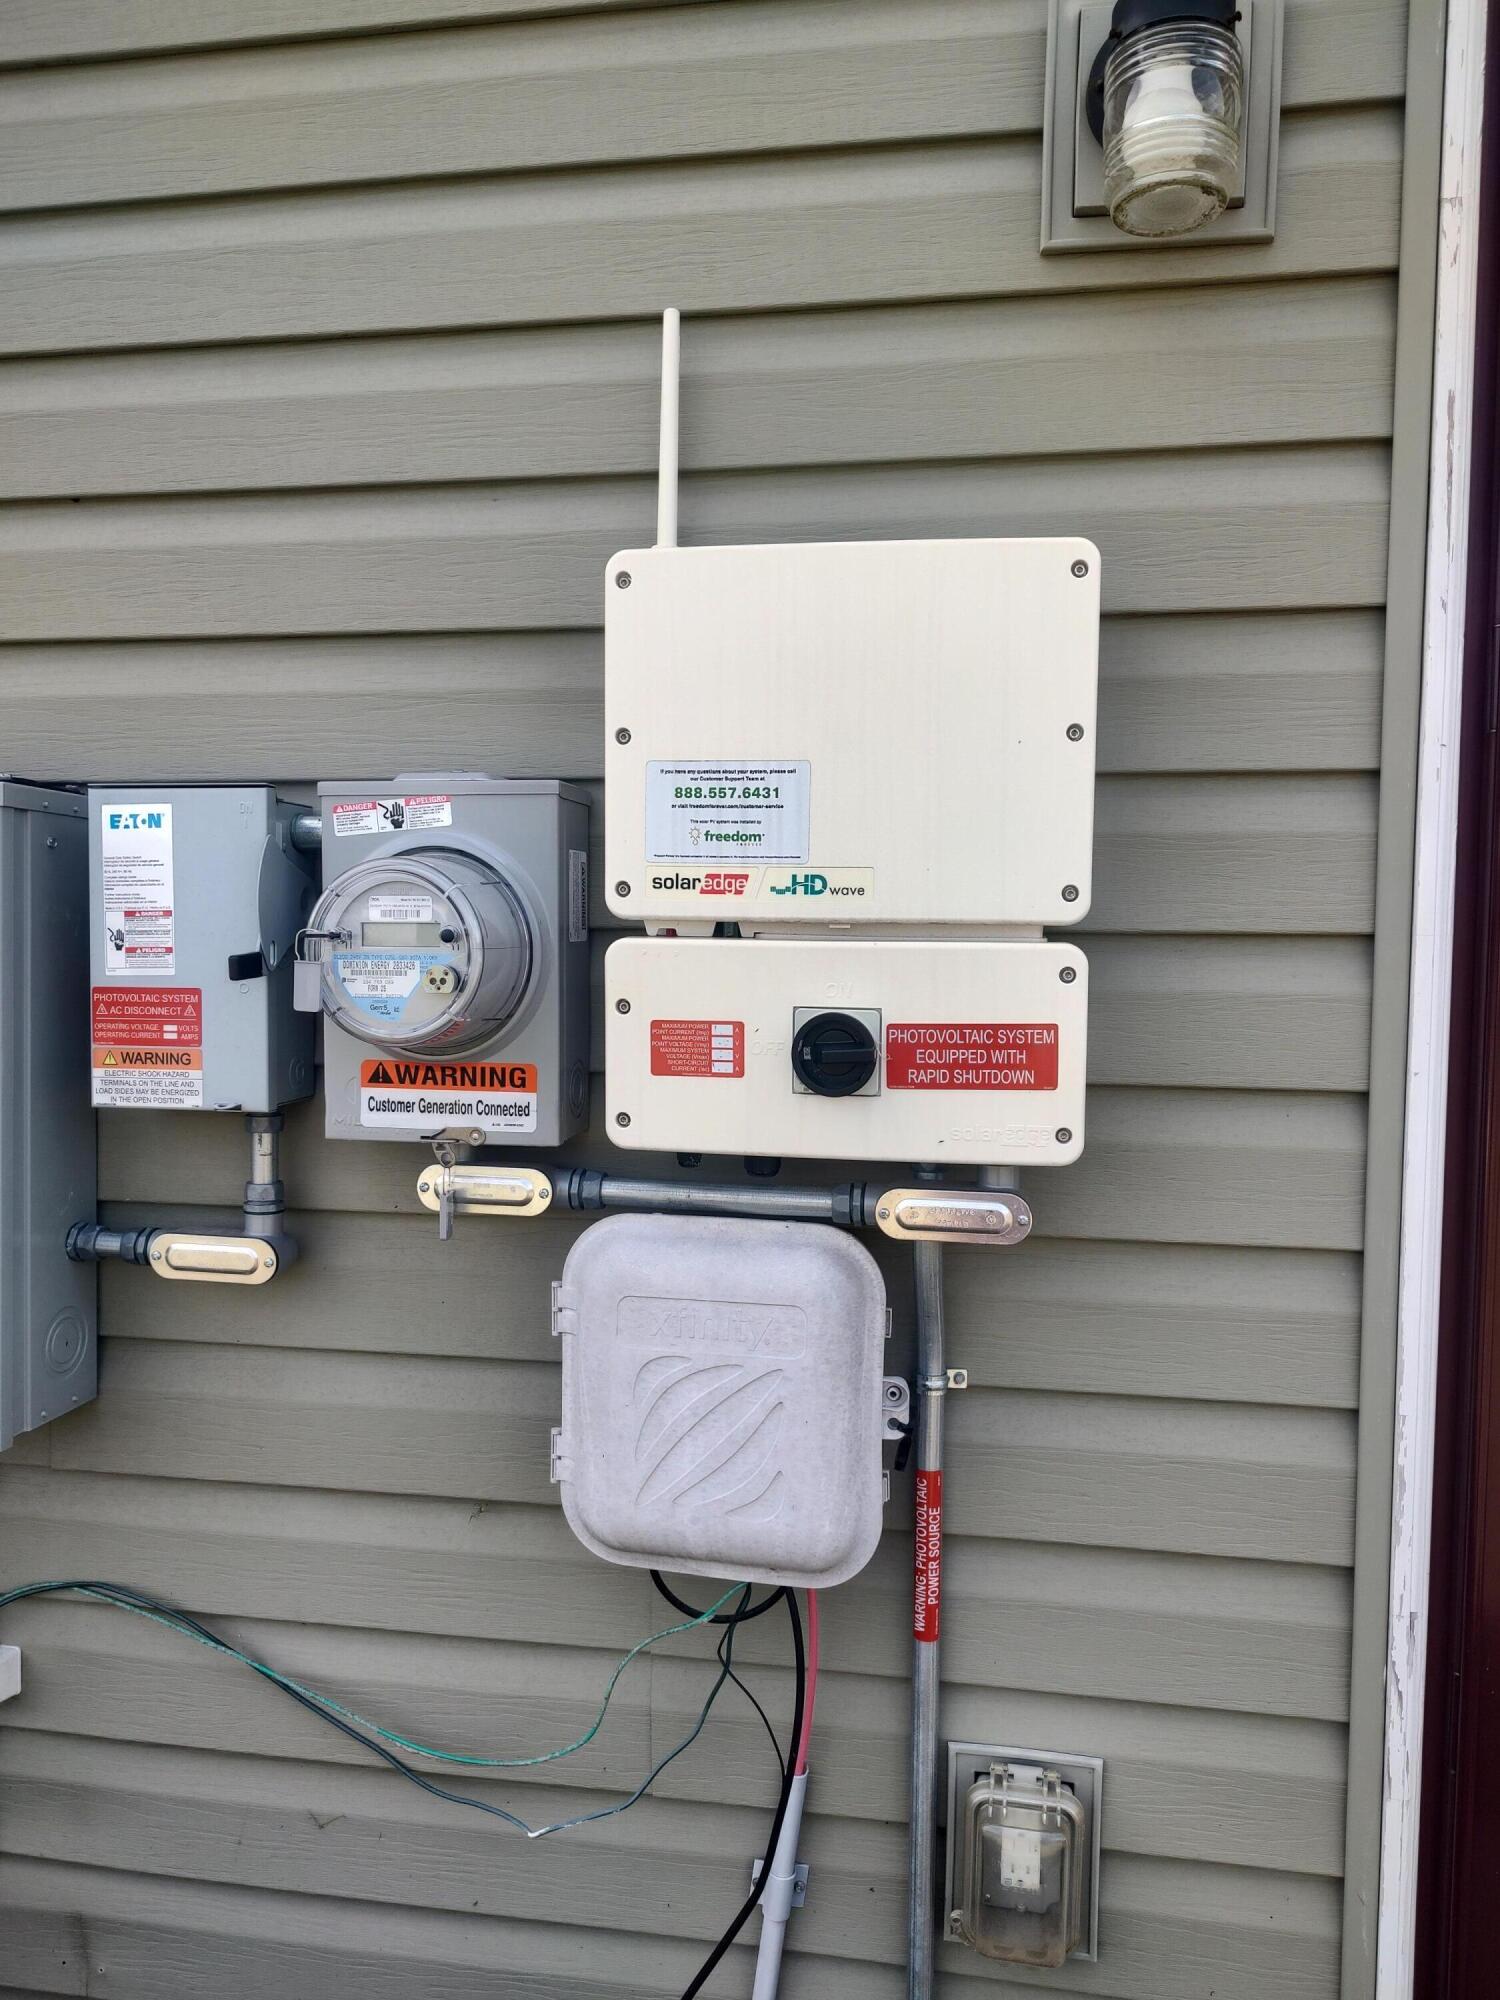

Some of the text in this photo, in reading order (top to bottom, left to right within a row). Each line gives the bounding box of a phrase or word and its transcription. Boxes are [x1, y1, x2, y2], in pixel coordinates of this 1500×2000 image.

[674, 786, 780, 799] 888.557.6431
[416, 795, 447, 804] PELIGRO
[343, 802, 373, 811] DANGER
[109, 813, 162, 830] EATON
[704, 830, 762, 842] freedom
[830, 885, 865, 896] wave
[343, 960, 368, 970] DOMINION
[371, 960, 390, 970] ENERGY
[94, 993, 199, 1003] PHOTOVOLTAIC SYSTEM
[110, 1006, 182, 1016] AC DISCONNECT
[94, 1023, 130, 1031] OPERATING
[178, 1024, 199, 1032] VOLTS
[94, 1031, 130, 1039] OPERATING
[888, 1029, 1055, 1045] PHOTOVOLTAIC SYSTEM
[751, 1039, 785, 1056] OFF
[120, 1051, 192, 1066] WARNING
[916, 1049, 1027, 1065] EQUIPPED WITH
[104, 1069, 136, 1077] ELECTRIC
[137, 1070, 161, 1078] SHOCK
[394, 1064, 527, 1088] WARNING
[908, 1069, 1036, 1085] RAPID SHUTDOWN
[100, 1079, 137, 1087] TERMINALS
[164, 1080, 179, 1088] LINE
[95, 1087, 114, 1095] LOAD
[114, 1088, 135, 1096] SIDES
[135, 1088, 149, 1096] MAY
[160, 1089, 200, 1098] ENERGIZED
[119, 1096, 131, 1104] THE
[152, 1097, 185, 1105] POSITION
[368, 1095, 530, 1117] Customer Generation Connected
[914, 1477, 927, 1632] WARNING: PHOTOVOLTAIC
[928, 1506, 941, 1605] POWER SOURCE
